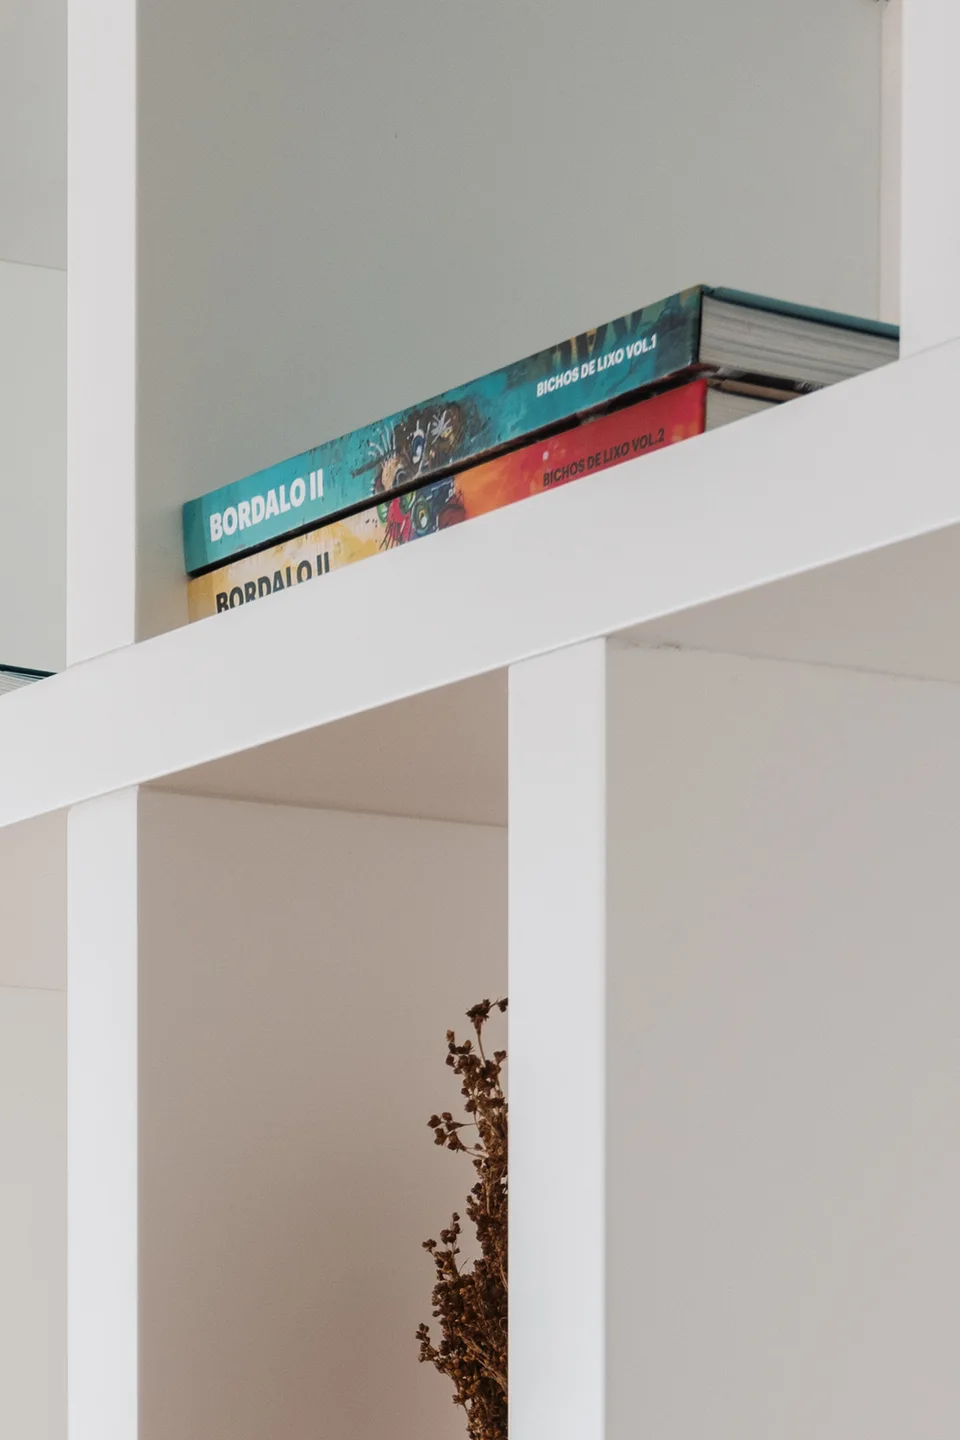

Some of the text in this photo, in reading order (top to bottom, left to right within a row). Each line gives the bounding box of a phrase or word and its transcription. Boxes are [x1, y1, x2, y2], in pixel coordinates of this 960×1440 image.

[536, 333, 657, 397] BICHOS DE LIXO VOL.1
[543, 461, 584, 487] BICHOS
[587, 453, 601, 469] DE
[604, 442, 629, 464] LIXO
[209, 468, 324, 542] BORDALO II
[216, 551, 330, 613] BORDALO II
